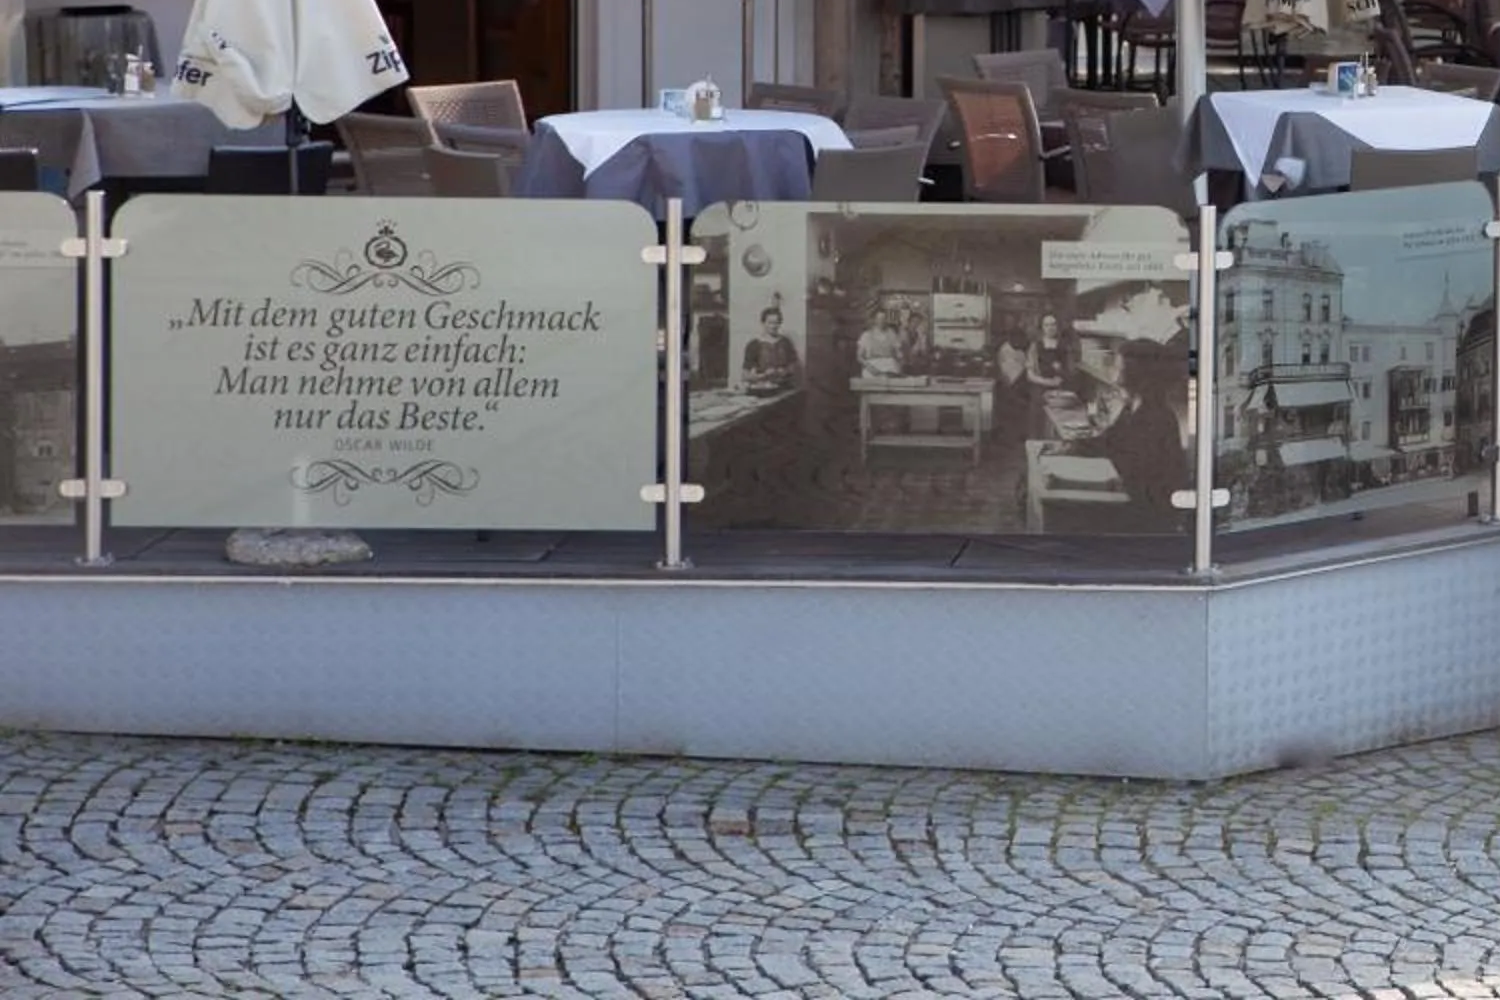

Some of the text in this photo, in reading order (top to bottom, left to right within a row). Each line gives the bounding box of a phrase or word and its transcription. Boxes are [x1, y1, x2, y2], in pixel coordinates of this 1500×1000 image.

[175, 58, 214, 87] fer
[168, 297, 602, 338] „Mit dem guten Geschmack
[244, 333, 526, 373] ist es ganz einfach:
[214, 365, 561, 398] Man nehme von allem
[274, 408, 331, 430] nur
[336, 400, 390, 431] das
[335, 438, 434, 452] OSCAR WILDE
